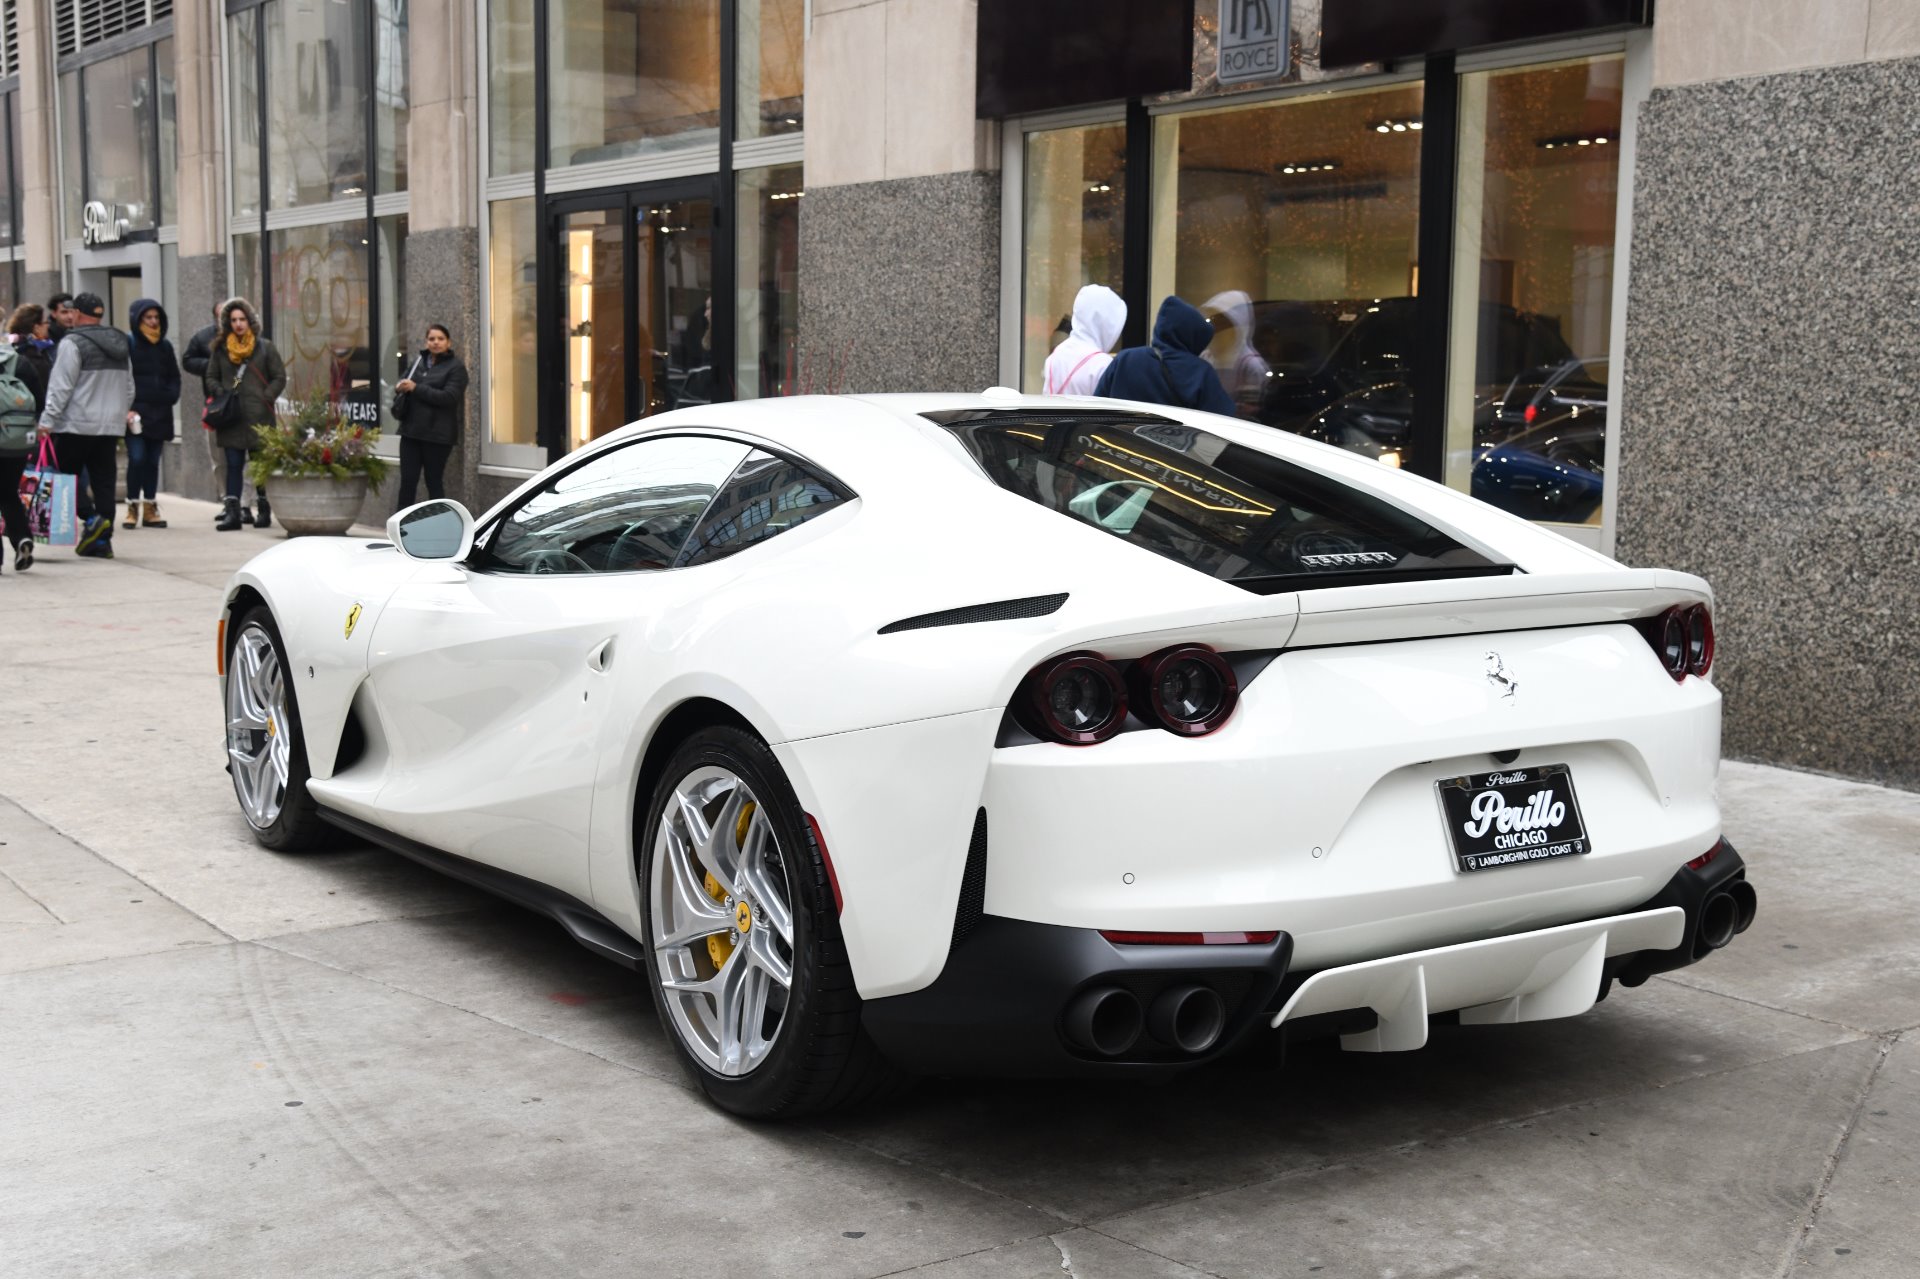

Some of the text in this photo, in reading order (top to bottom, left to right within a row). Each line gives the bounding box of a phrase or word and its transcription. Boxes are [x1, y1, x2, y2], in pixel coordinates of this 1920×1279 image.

[1223, 46, 1275, 71] ROYCE
[1485, 771, 1527, 787] Perillo
[1464, 789, 1566, 838] Perillo
[1494, 830, 1548, 849] CHICAGO
[1478, 843, 1572, 867] LAMBORGHINI GOLD COAST
